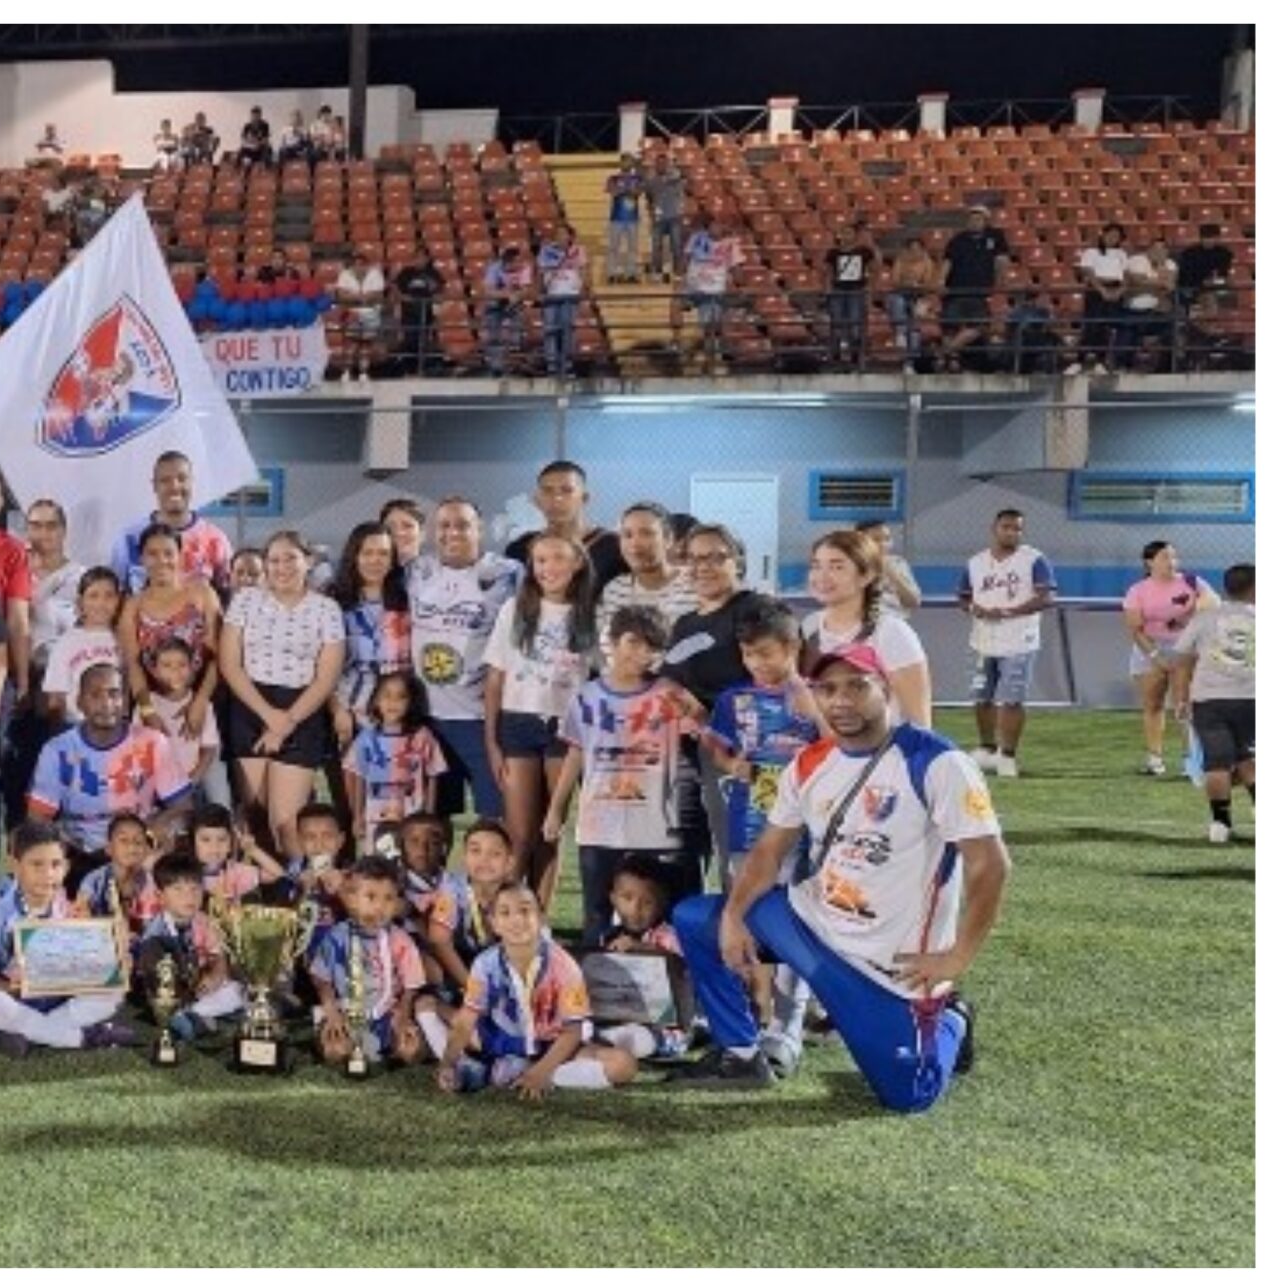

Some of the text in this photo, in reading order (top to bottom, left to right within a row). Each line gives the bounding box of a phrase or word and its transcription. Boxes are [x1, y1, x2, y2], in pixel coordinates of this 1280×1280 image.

[216, 334, 300, 365] QUE TU
[226, 366, 313, 392] CONTIGO
